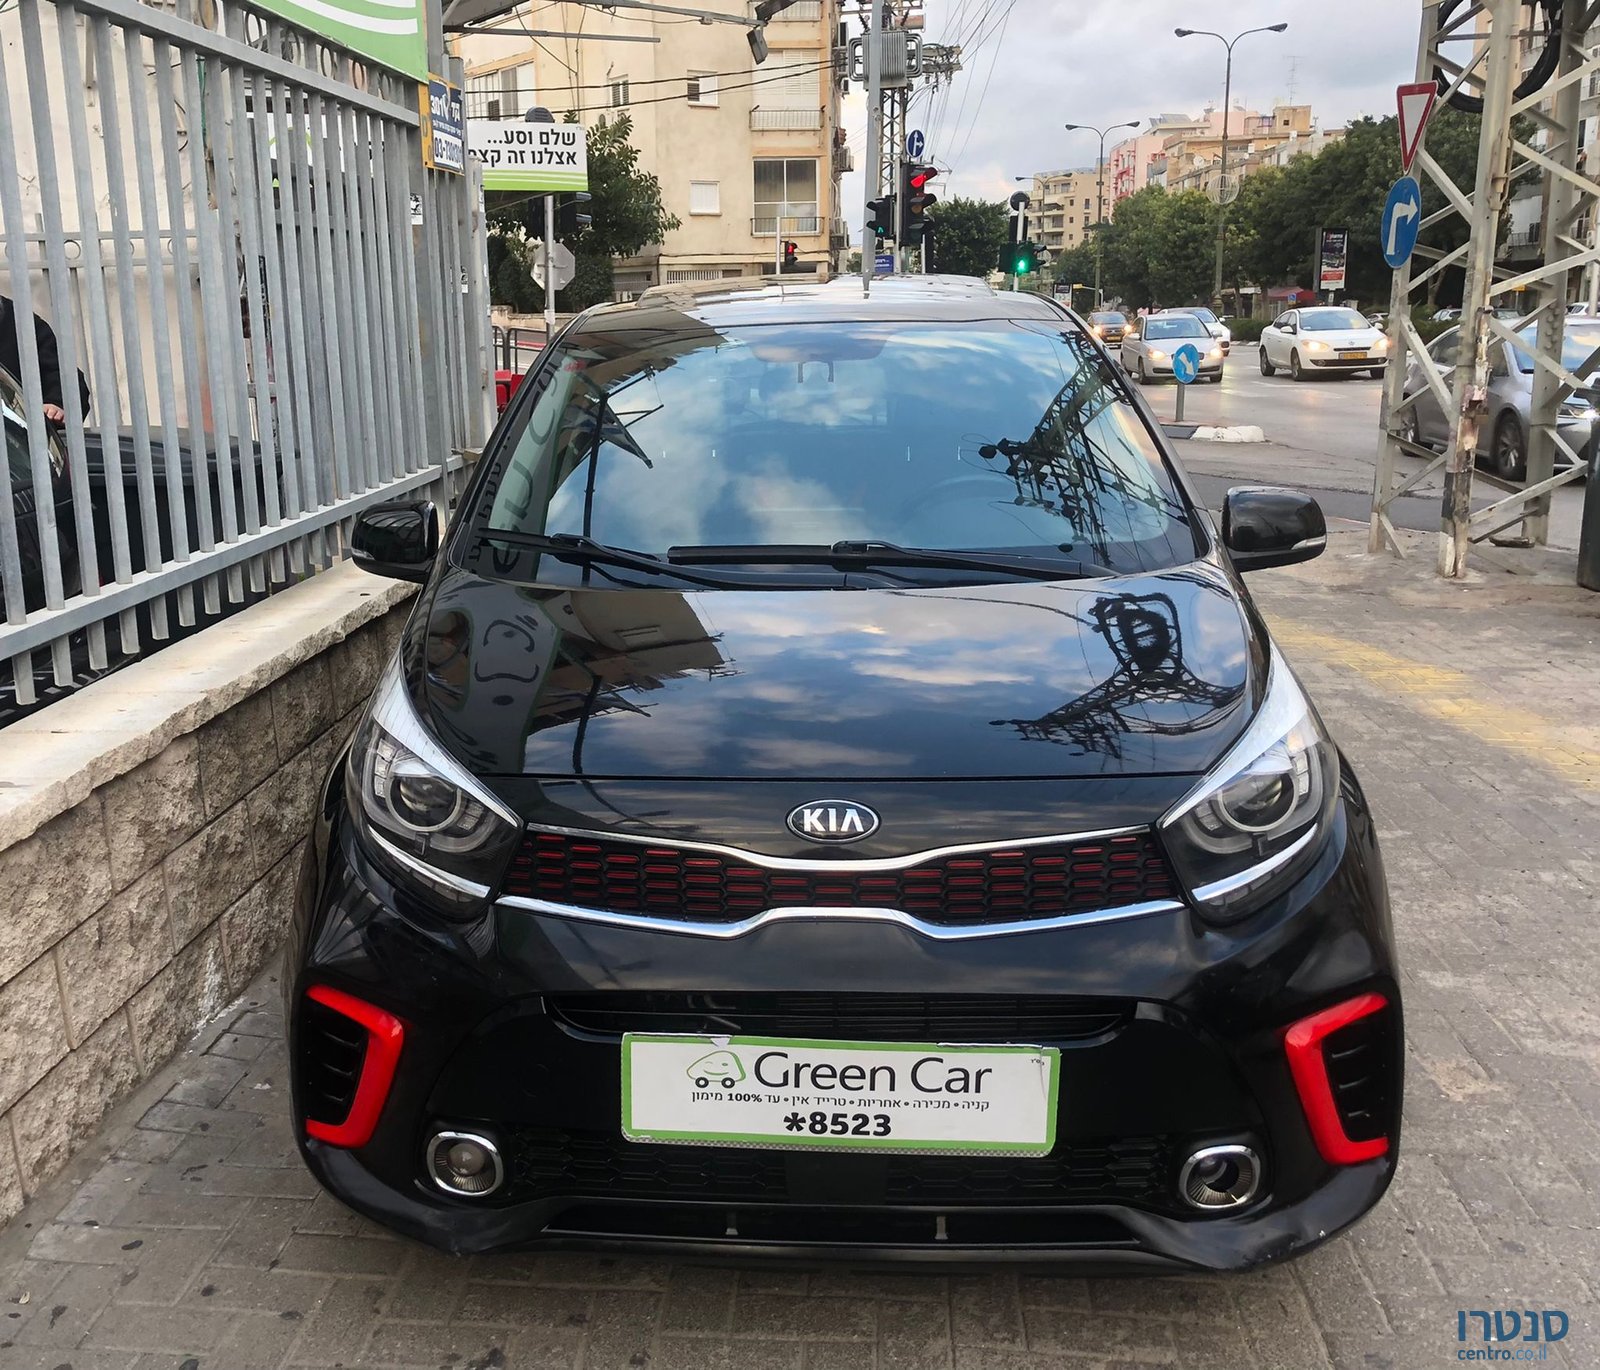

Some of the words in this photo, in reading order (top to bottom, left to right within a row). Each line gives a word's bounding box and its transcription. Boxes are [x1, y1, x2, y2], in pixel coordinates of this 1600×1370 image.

[487, 130, 533, 145] וסע...
[540, 128, 576, 146] שלם
[507, 150, 526, 164] זה
[530, 147, 577, 165] אצלנו
[802, 808, 864, 832] KIA
[754, 1051, 896, 1092] Green
[910, 1056, 993, 1094] Car
[691, 1091, 723, 1103] מימון
[727, 1092, 762, 1103] 100%
[764, 1094, 780, 1103] עד
[792, 1096, 810, 1106] אין
[813, 1096, 846, 1106] טרייד
[857, 1098, 901, 1109] אחריות
[912, 1099, 951, 1110] מכירה
[962, 1101, 990, 1112] קניה
